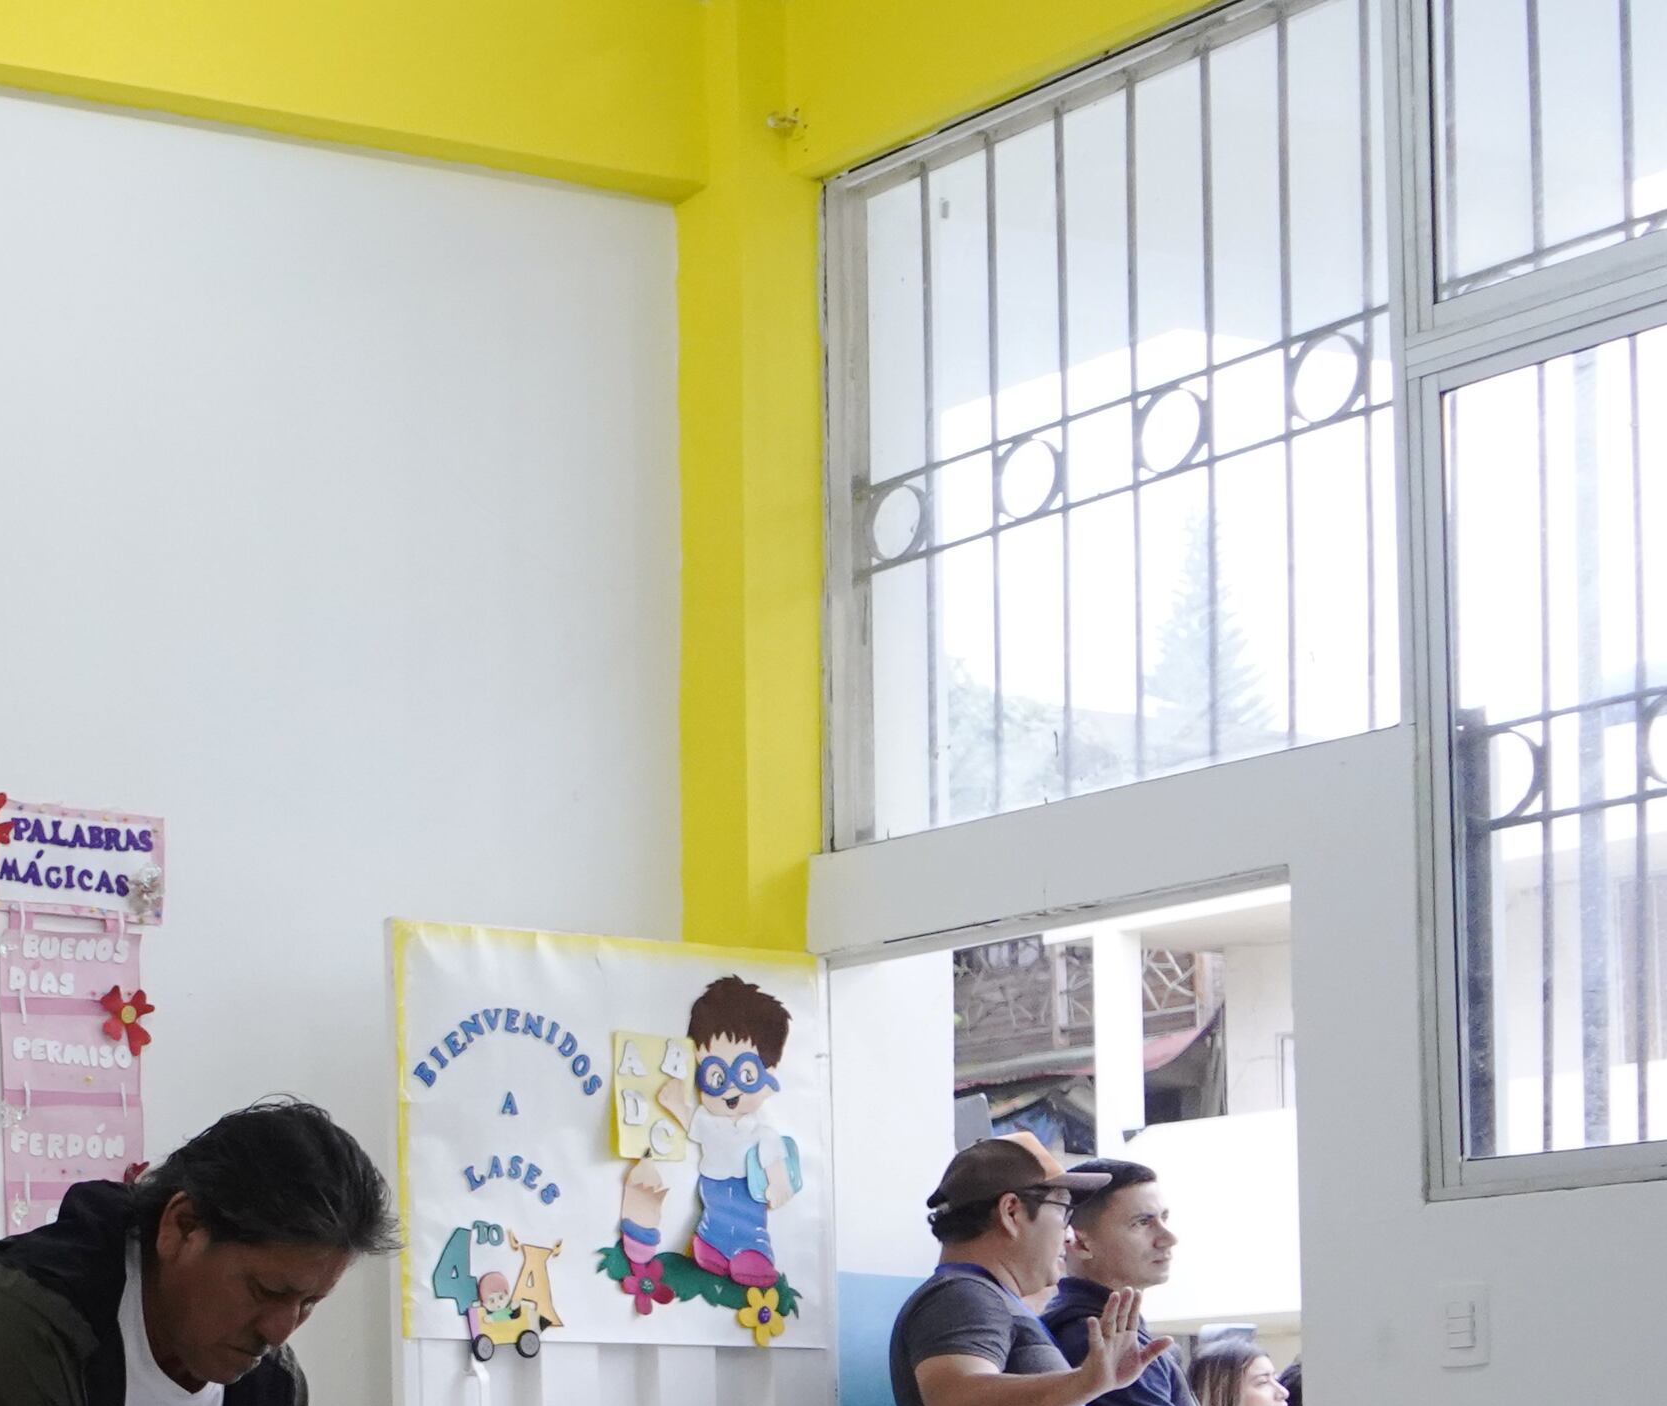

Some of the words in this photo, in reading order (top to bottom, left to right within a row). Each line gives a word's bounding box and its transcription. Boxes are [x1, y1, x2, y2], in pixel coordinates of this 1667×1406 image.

[11, 816, 154, 853] PALABRAS
[22, 933, 130, 965] BUENOS
[13, 1036, 132, 1070] PERMISO
[413, 1008, 603, 1096] BIENVENIDOS
[501, 1091, 518, 1116] A
[10, 1123, 125, 1160] PERDÓN
[464, 1154, 561, 1205] LASES
[432, 1227, 478, 1316] 4
[472, 1220, 505, 1247] TO
